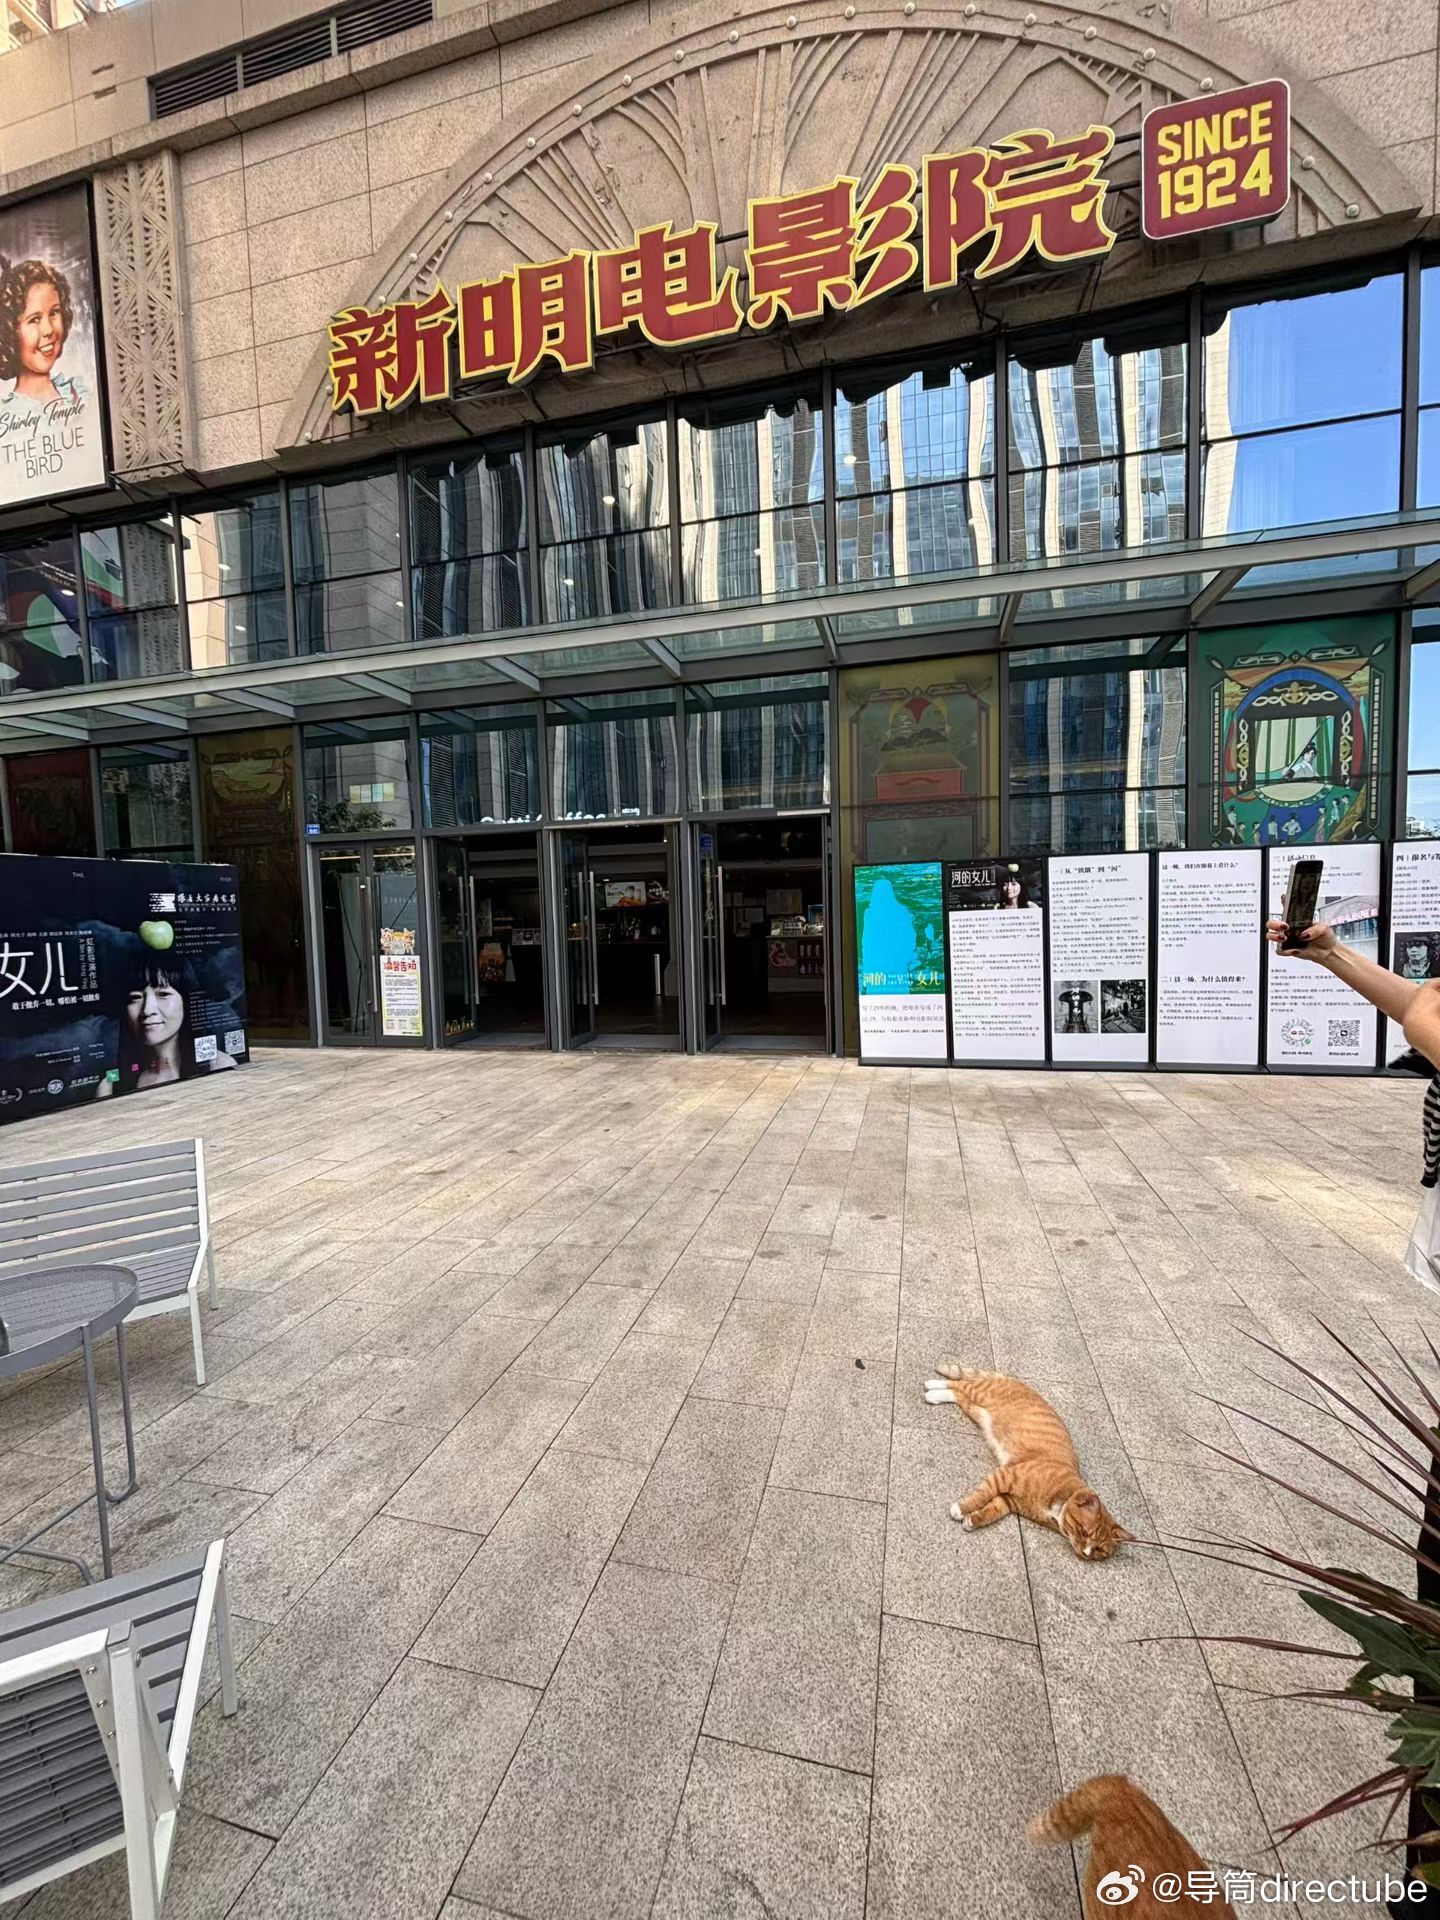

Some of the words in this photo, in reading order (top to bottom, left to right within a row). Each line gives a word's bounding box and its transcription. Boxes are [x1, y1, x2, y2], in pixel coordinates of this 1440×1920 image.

[1157, 100, 1274, 165] SINCE
[1157, 147, 1274, 220] 1924
[328, 124, 1116, 416] 新明电影院
[0, 410, 41, 438] Shirley
[43, 397, 85, 427] Temple
[2, 438, 36, 464] THE
[42, 426, 84, 455] BLUE
[26, 453, 63, 479] BIRD
[951, 869, 991, 885] 河的女儿
[917, 970, 941, 986] 女儿
